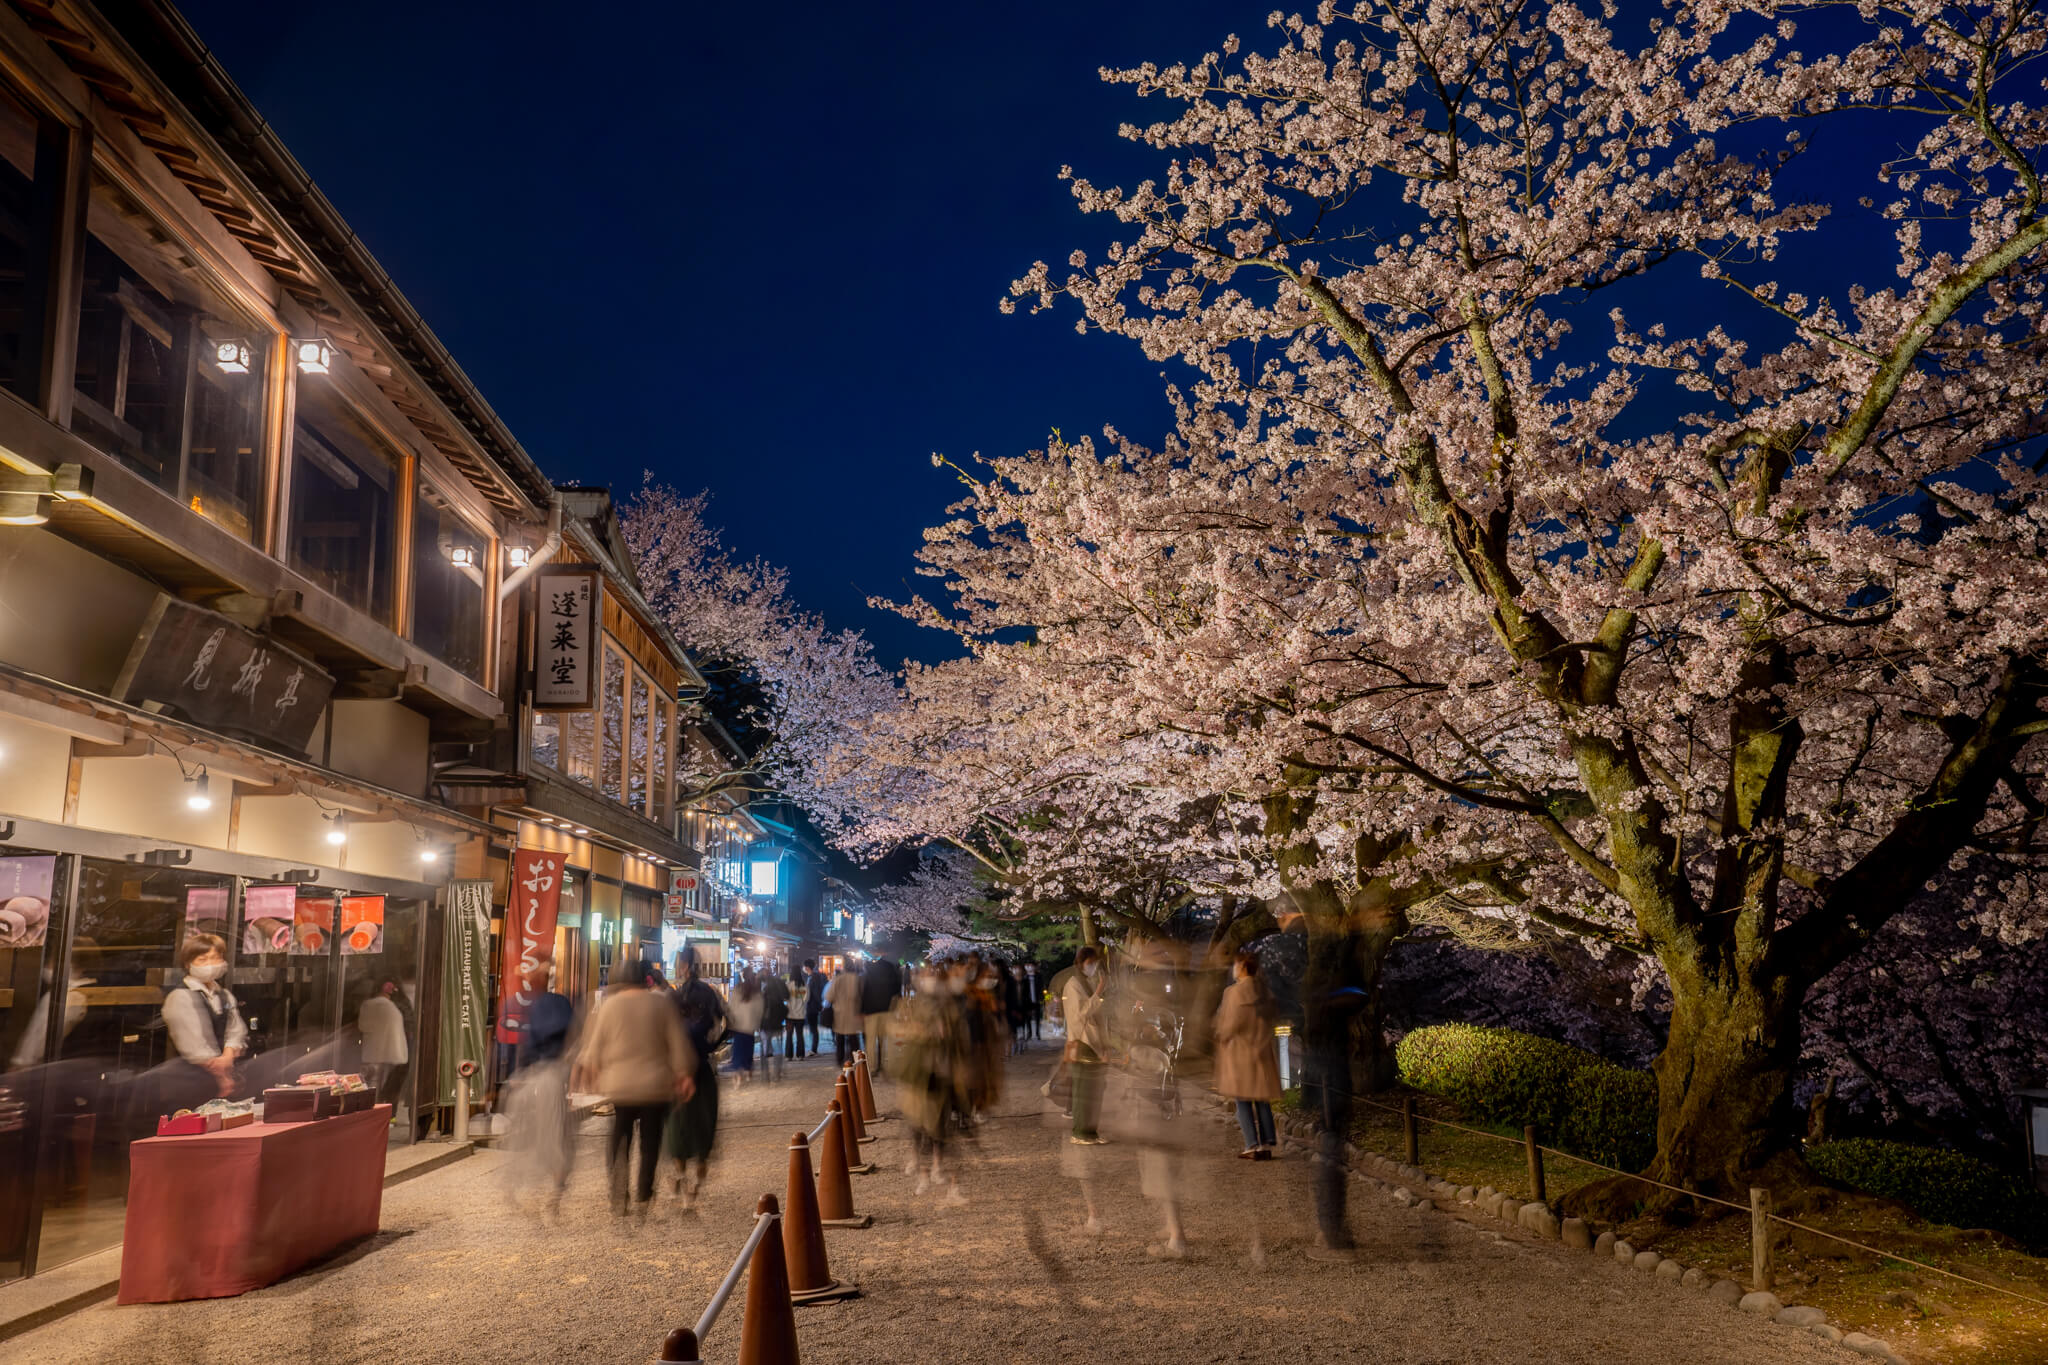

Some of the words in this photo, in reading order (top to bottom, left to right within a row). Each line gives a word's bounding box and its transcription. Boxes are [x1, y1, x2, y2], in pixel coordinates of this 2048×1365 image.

[182, 627, 304, 719] 見城亭
[550, 590, 579, 685] 蓬莱堂
[462, 930, 473, 990] RESTAURANT
[516, 859, 555, 1007] おしるこ
